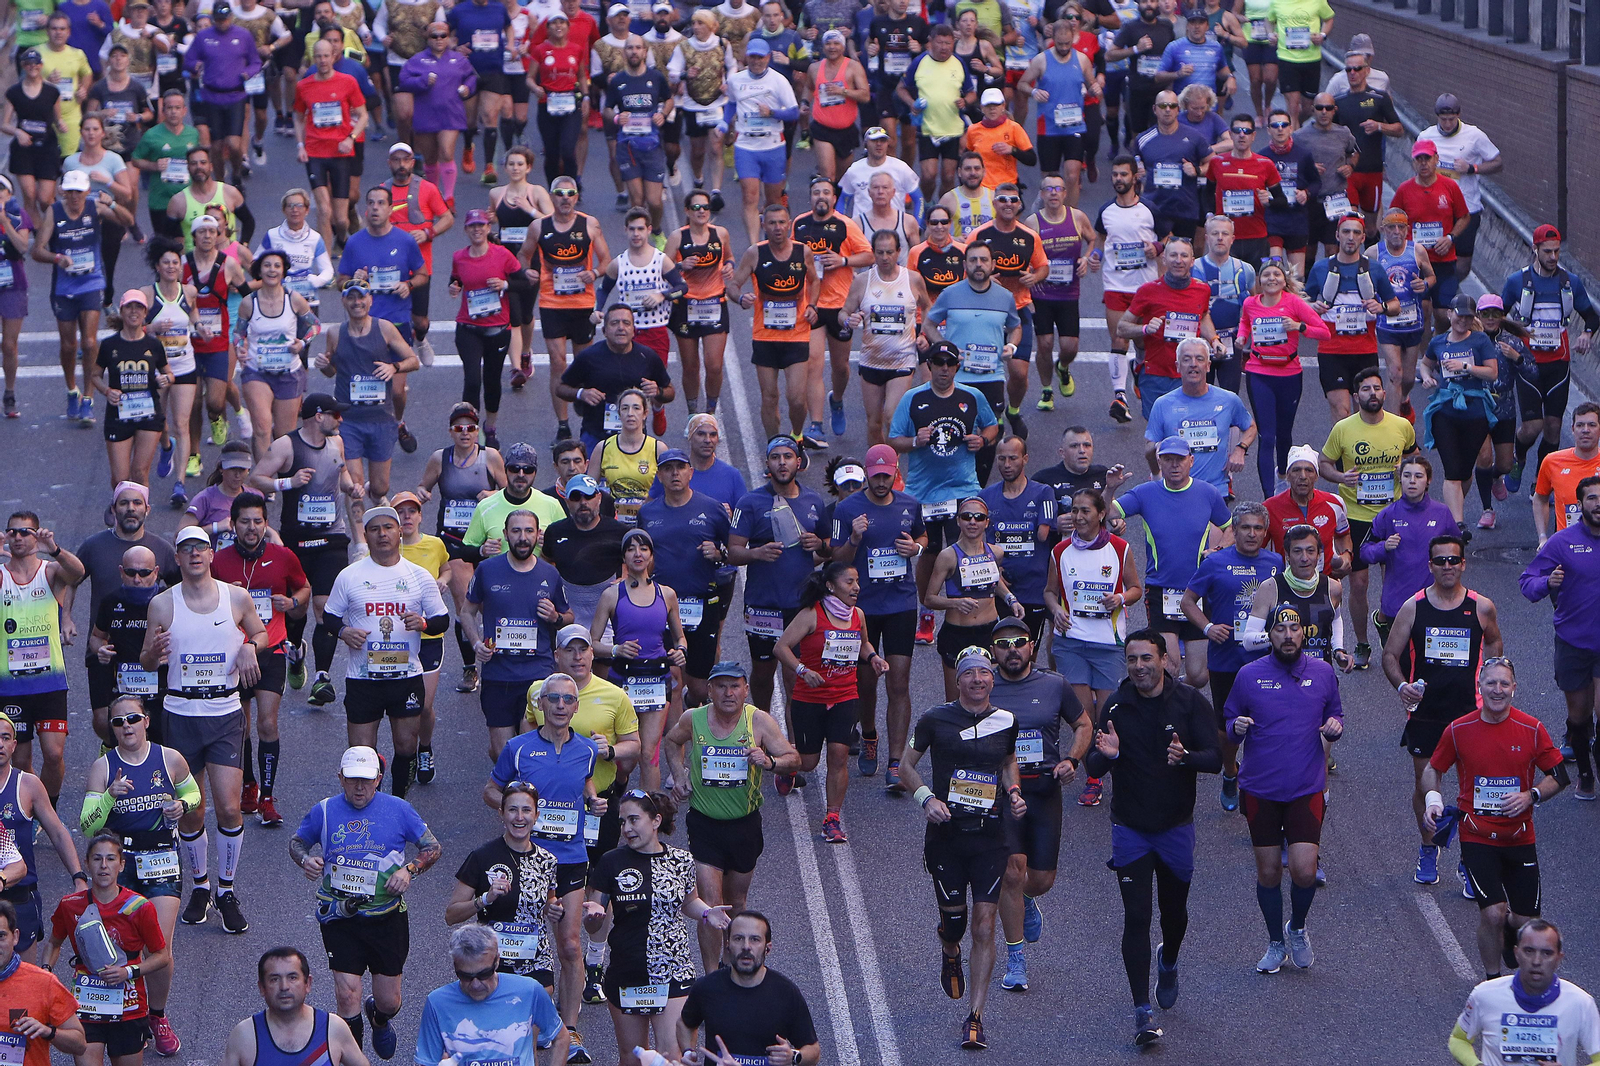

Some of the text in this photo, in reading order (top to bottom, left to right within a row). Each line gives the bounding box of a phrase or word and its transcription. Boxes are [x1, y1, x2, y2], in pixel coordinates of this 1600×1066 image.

[807, 238, 827, 250] aodi
[556, 244, 577, 256] aodi
[997, 253, 1019, 266] aodi
[379, 265, 398, 273] ZURICH
[562, 265, 585, 273] ZURICH
[933, 268, 954, 281] aodi
[774, 276, 794, 288] aodi
[881, 305, 901, 313] ZURICH
[1176, 312, 1198, 321] ZURICH
[1261, 317, 1282, 325] ZURICH
[1450, 350, 1471, 359] ZURICH
[116, 360, 150, 373] 100
[120, 373, 149, 385] BEHOBIA
[129, 390, 150, 401] ZURICH
[1190, 419, 1213, 428] ZURICH
[1369, 473, 1392, 481] ZURICH
[1367, 483, 1385, 491] 13715
[1006, 522, 1029, 530] ZURICH
[879, 560, 899, 568] 12252
[971, 567, 991, 576] 11494
[971, 576, 993, 584] ROSMARY
[365, 602, 406, 617] PERU
[756, 609, 780, 618] ZURICH
[111, 619, 123, 628] LOS
[509, 618, 533, 627] ZURICH
[19, 623, 52, 634] PINTADO
[1440, 629, 1466, 637] ZURICH
[506, 632, 527, 640] 10366
[20, 638, 45, 646] ZURICH
[381, 642, 405, 650] ZURICH
[1437, 641, 1459, 649] 12855
[21, 652, 38, 660] 7887
[195, 654, 221, 663] ZURICH
[195, 669, 213, 677] 9579
[126, 676, 146, 684] 11894
[5, 706, 19, 714] KIA
[716, 748, 744, 756] ZURICH
[713, 761, 736, 769] 11914
[263, 752, 276, 788] Kalenji
[719, 772, 730, 780] LUIS
[968, 771, 994, 783] ZURICH
[1488, 777, 1516, 786] ZURICH
[964, 787, 983, 796] 4978
[548, 800, 574, 809] ZURICH
[960, 796, 983, 806] PHILIPPE
[543, 813, 566, 822] 12590
[542, 825, 565, 833] ANTONIO
[148, 856, 171, 866] 13116
[346, 857, 374, 870] ZURICH
[143, 868, 177, 879] JESUS ANGEL
[341, 872, 365, 884] 10376
[341, 883, 362, 892] 044111
[616, 893, 647, 903] NOELIA
[504, 924, 534, 935] ZURICH
[499, 937, 524, 947] 13047
[501, 950, 519, 958] SILVIA
[633, 987, 658, 996] 13288
[86, 992, 110, 1002] 12982
[635, 998, 655, 1006] NOELIA
[1518, 1016, 1553, 1026] ZURICH
[1515, 1033, 1542, 1042] 12761
[1501, 1045, 1555, 1055] DARIO GONZALEZ
[735, 1056, 765, 1066] ZURICH
